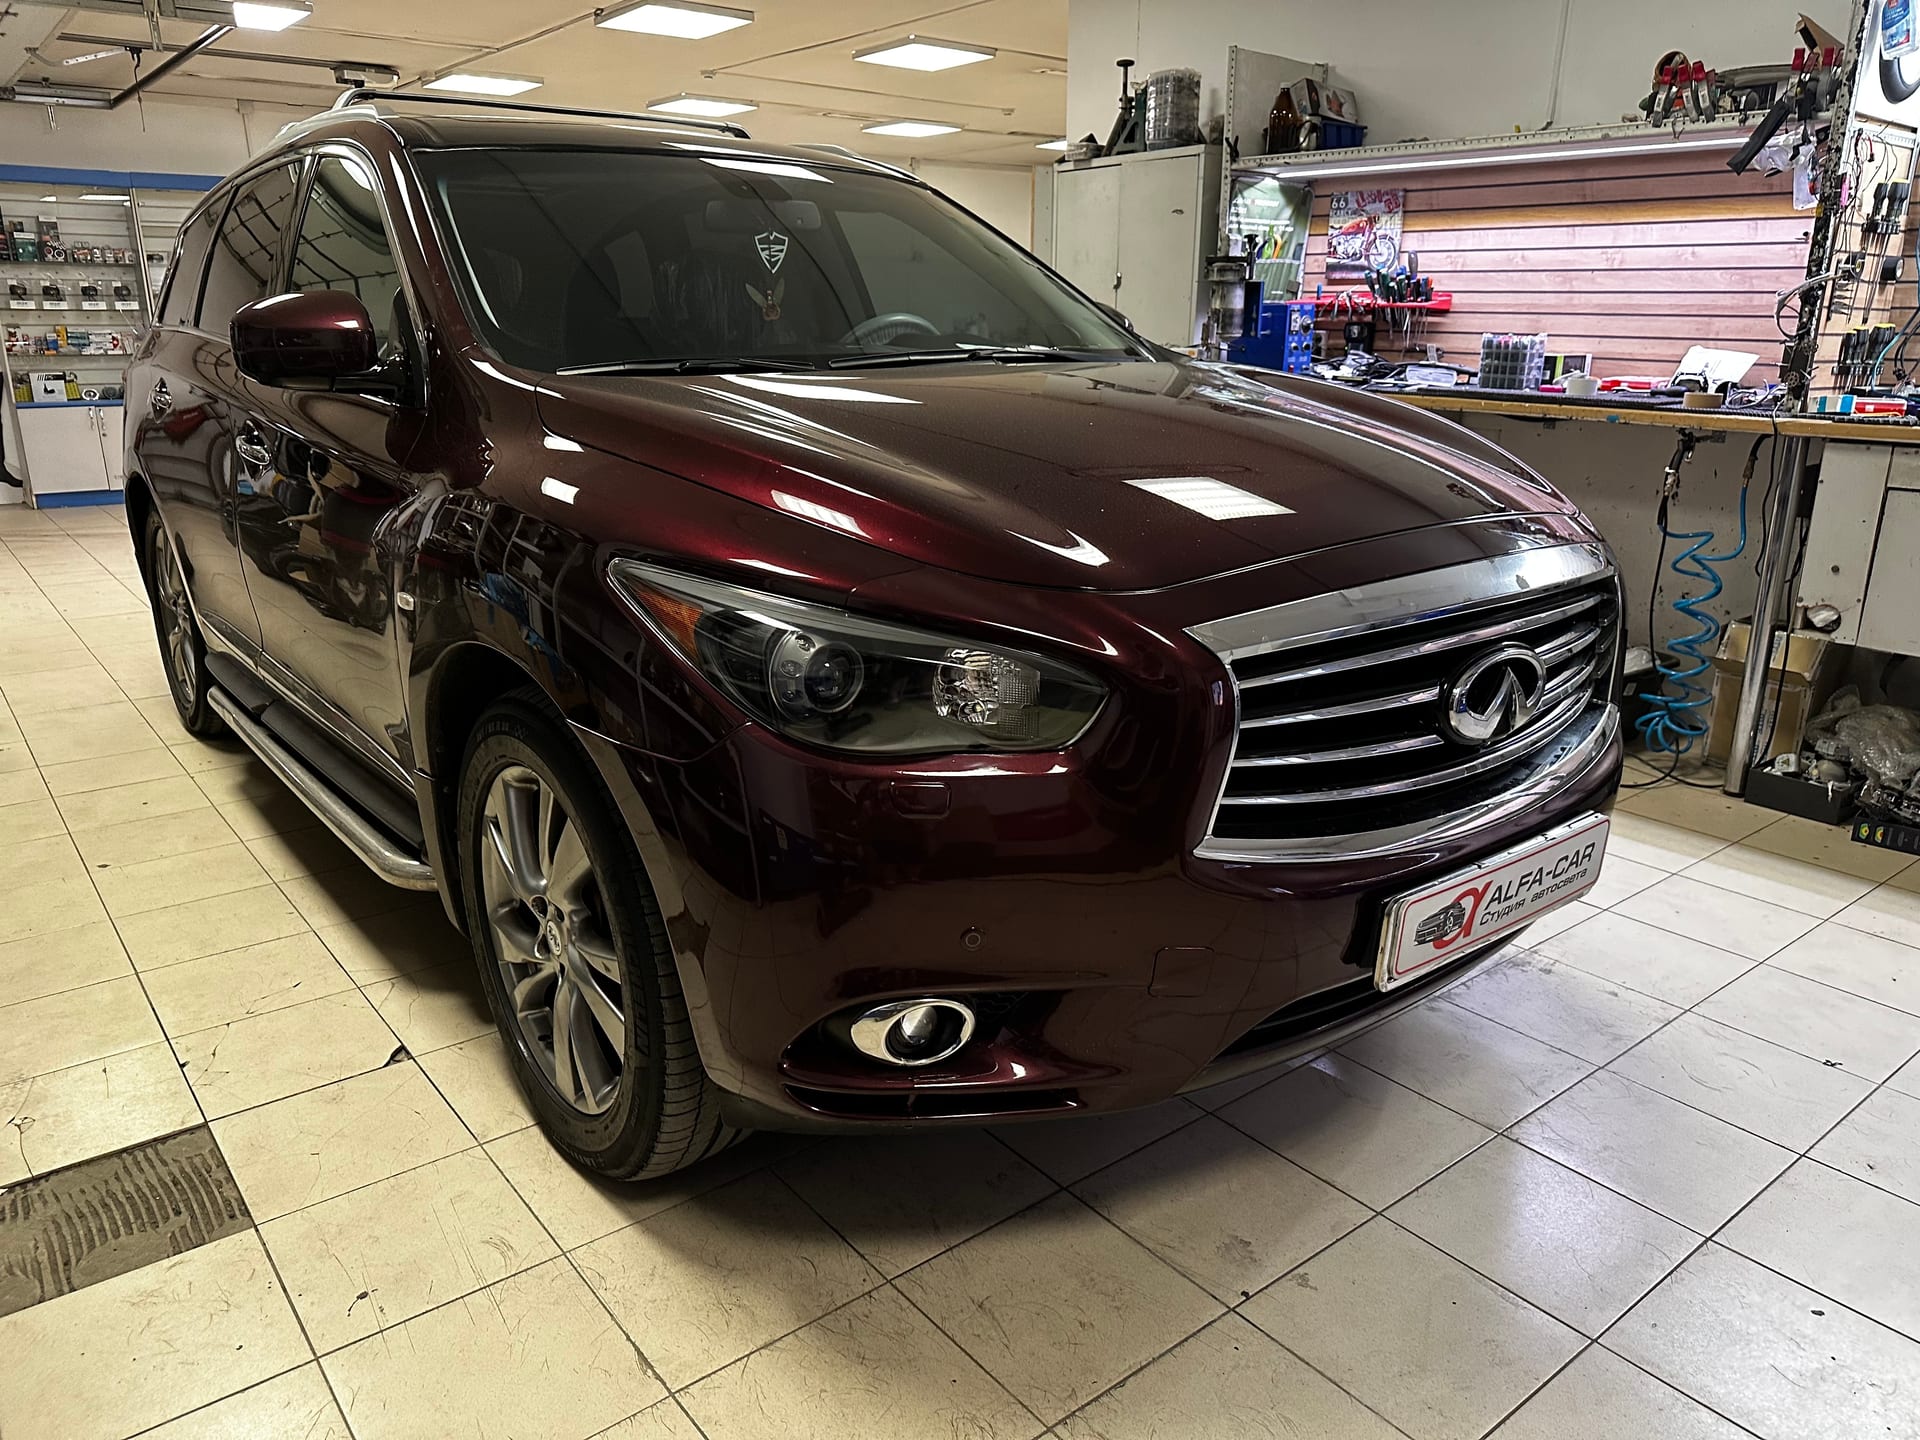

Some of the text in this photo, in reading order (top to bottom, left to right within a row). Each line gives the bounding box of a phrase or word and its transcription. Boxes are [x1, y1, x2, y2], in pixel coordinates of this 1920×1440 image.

[1331, 198, 1346, 209] 66
[1479, 868, 1588, 926] Студия автосвета
[1484, 841, 1596, 911] ALFA-CAR
